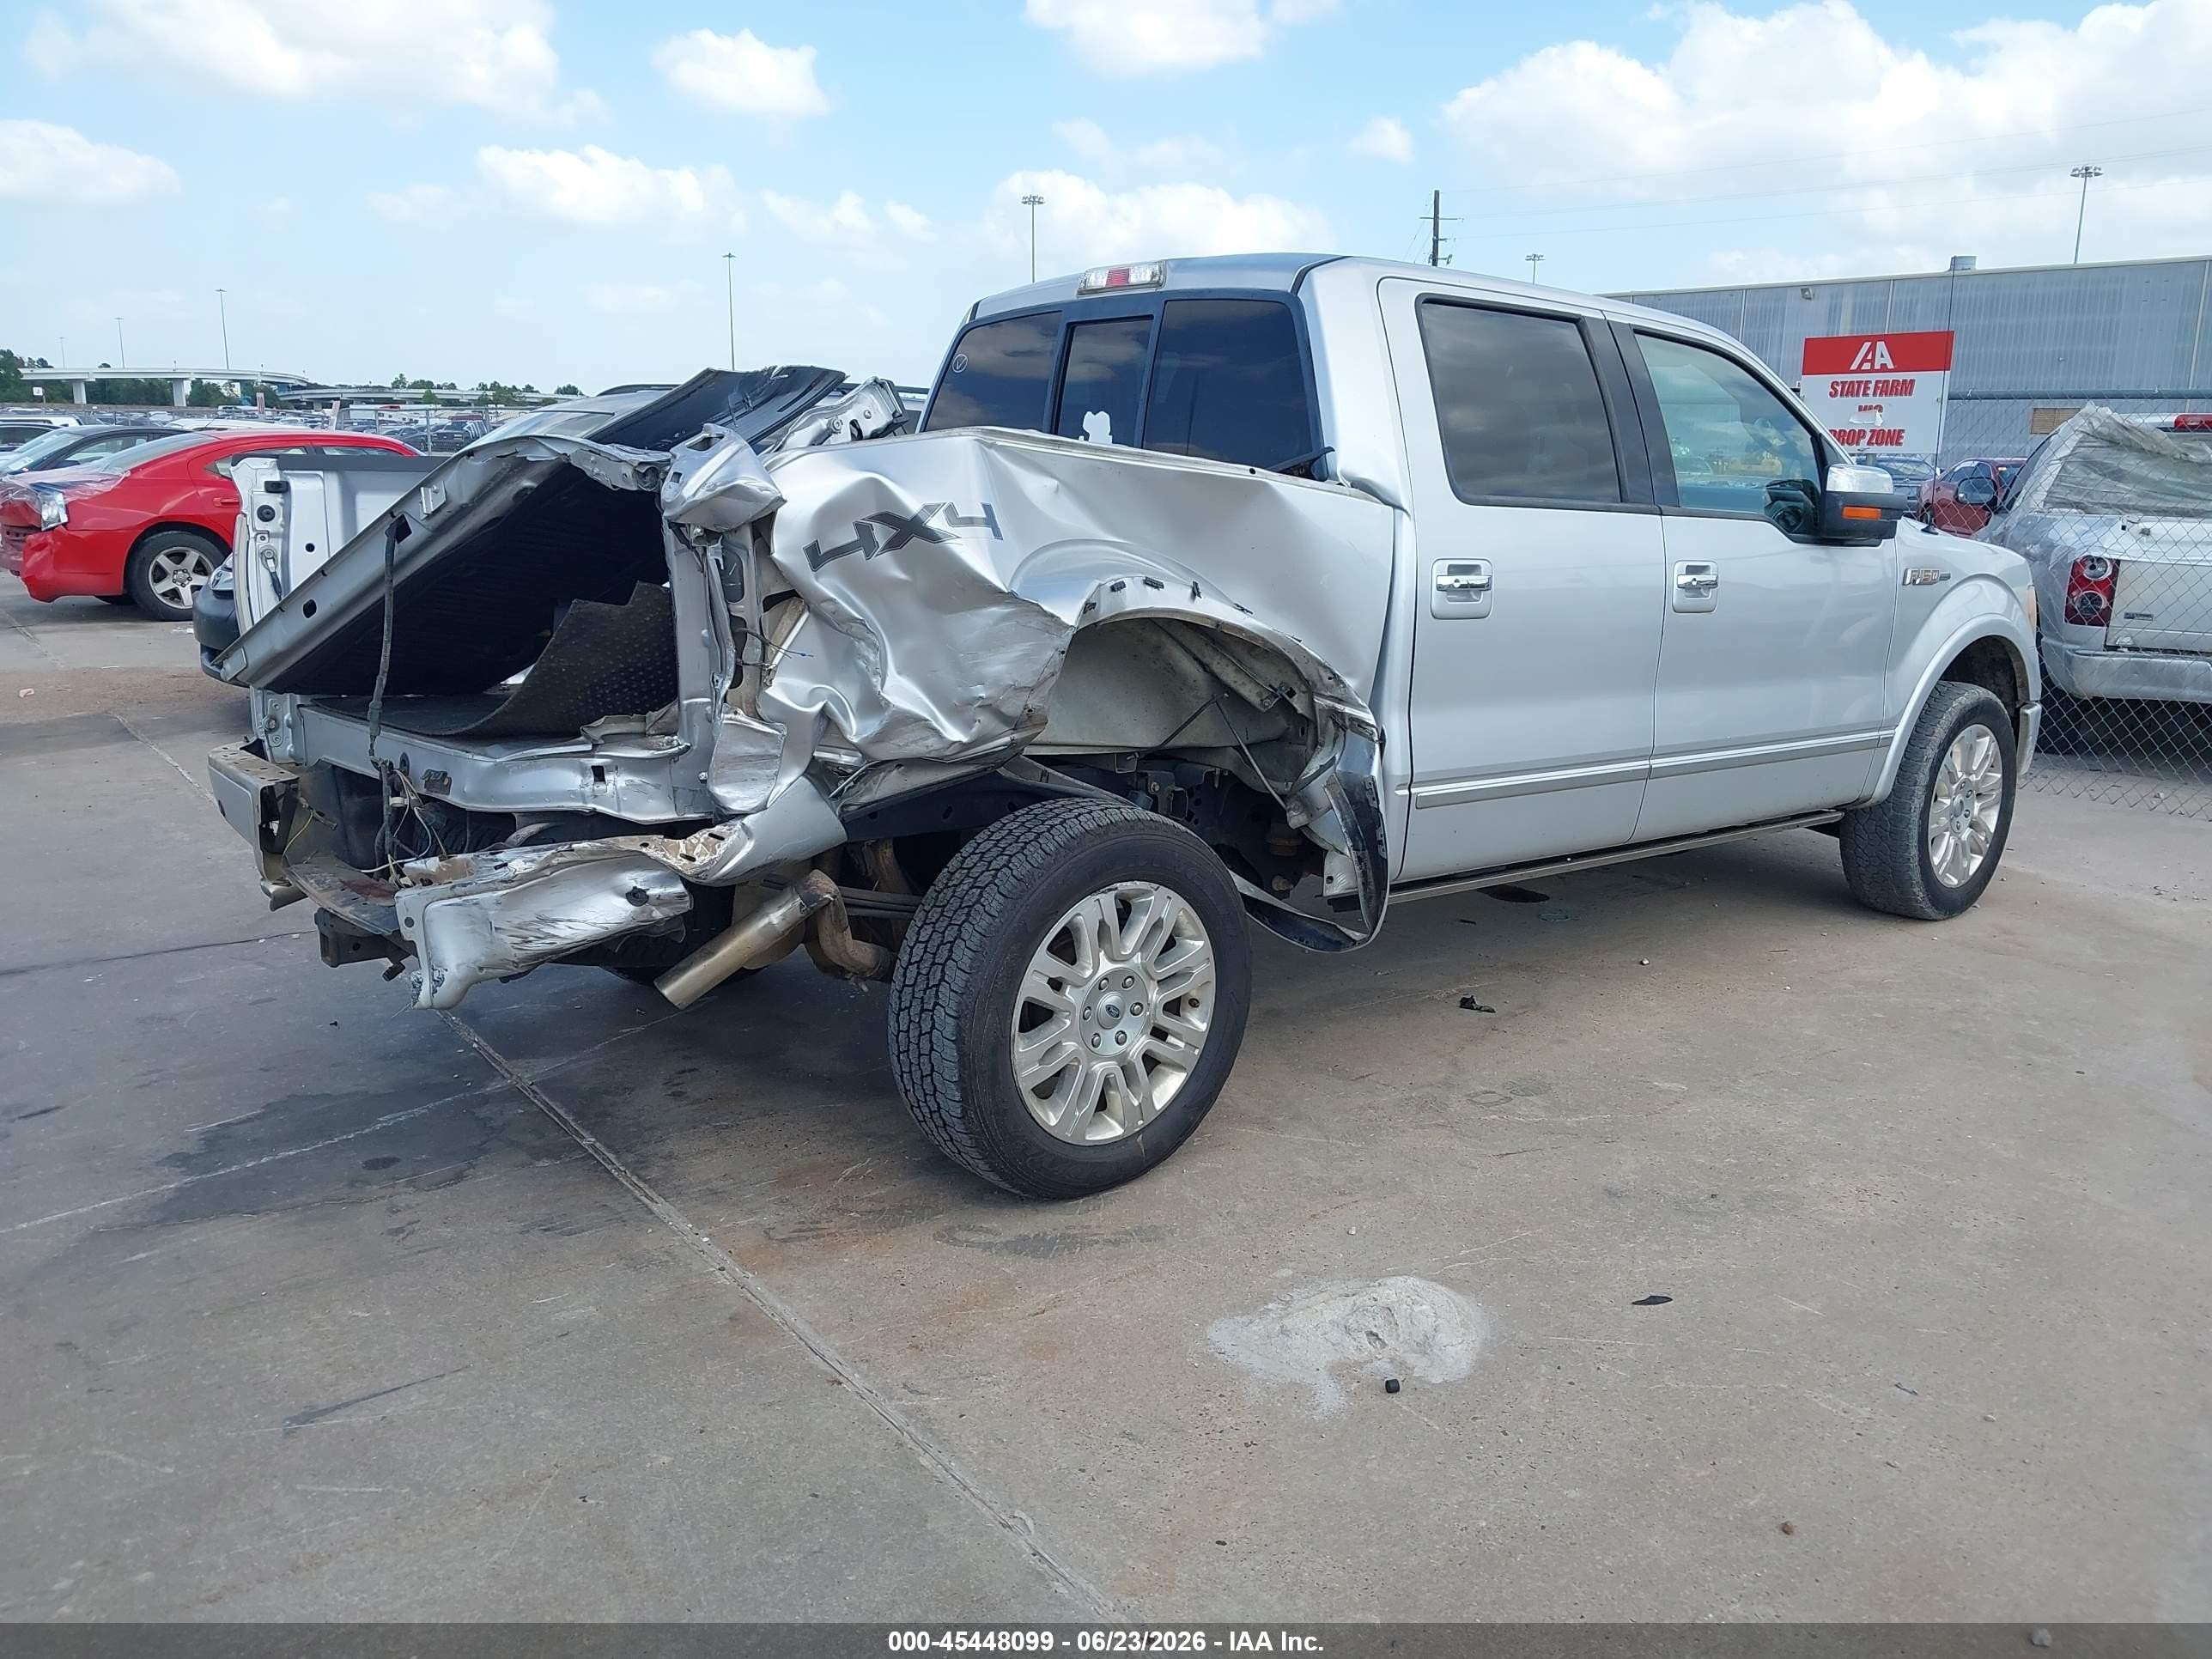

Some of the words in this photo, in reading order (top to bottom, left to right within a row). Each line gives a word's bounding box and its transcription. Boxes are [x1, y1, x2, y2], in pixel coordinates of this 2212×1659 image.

[1829, 380, 1872, 398] STATE
[1872, 379, 1916, 398] FARM
[1867, 428, 1905, 447] ZONE
